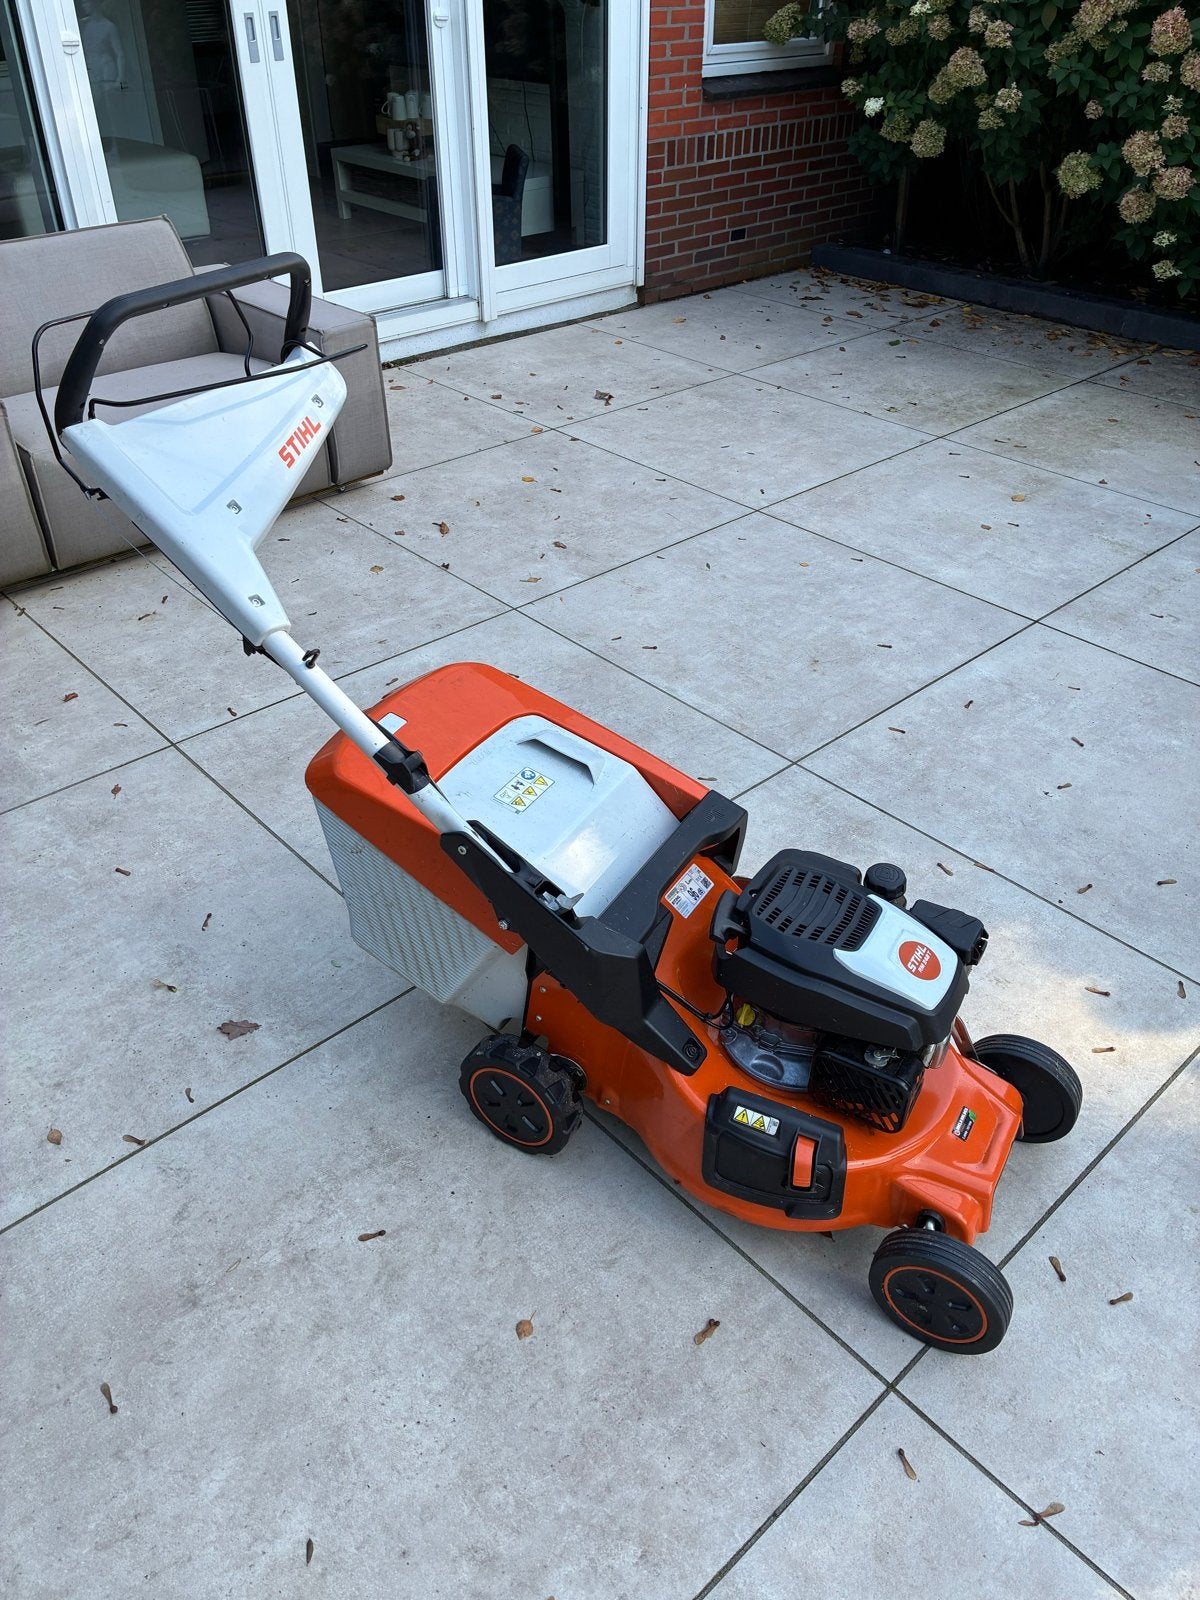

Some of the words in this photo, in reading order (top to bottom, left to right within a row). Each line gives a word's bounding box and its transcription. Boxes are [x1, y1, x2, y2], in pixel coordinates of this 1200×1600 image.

[278, 416, 321, 469] STIHL
[907, 945, 927, 973] STIHL
[917, 962, 926, 973] RM
